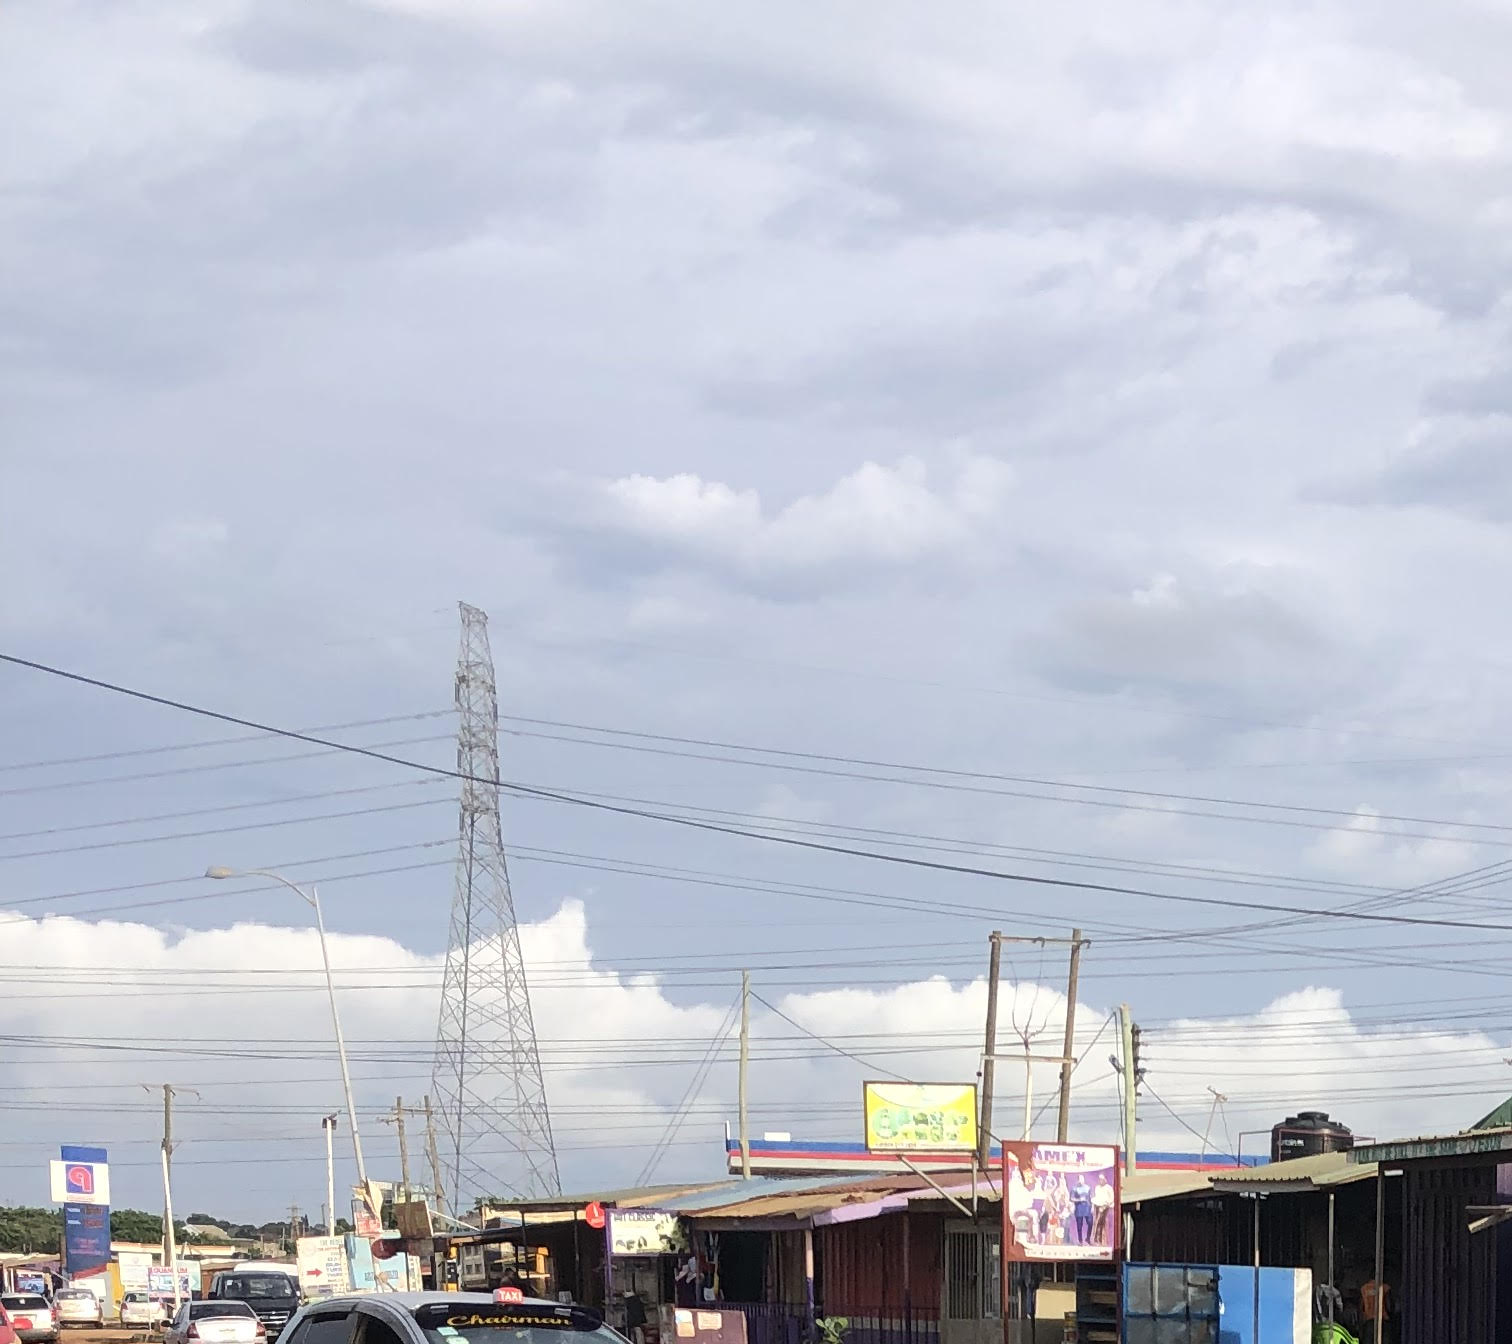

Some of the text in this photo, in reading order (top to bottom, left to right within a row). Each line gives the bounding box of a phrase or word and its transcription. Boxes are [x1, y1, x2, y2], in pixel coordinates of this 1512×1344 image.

[153, 1266, 188, 1274] QUANUM
[500, 1290, 522, 1302] TAXI
[447, 1314, 573, 1326] Chairman
